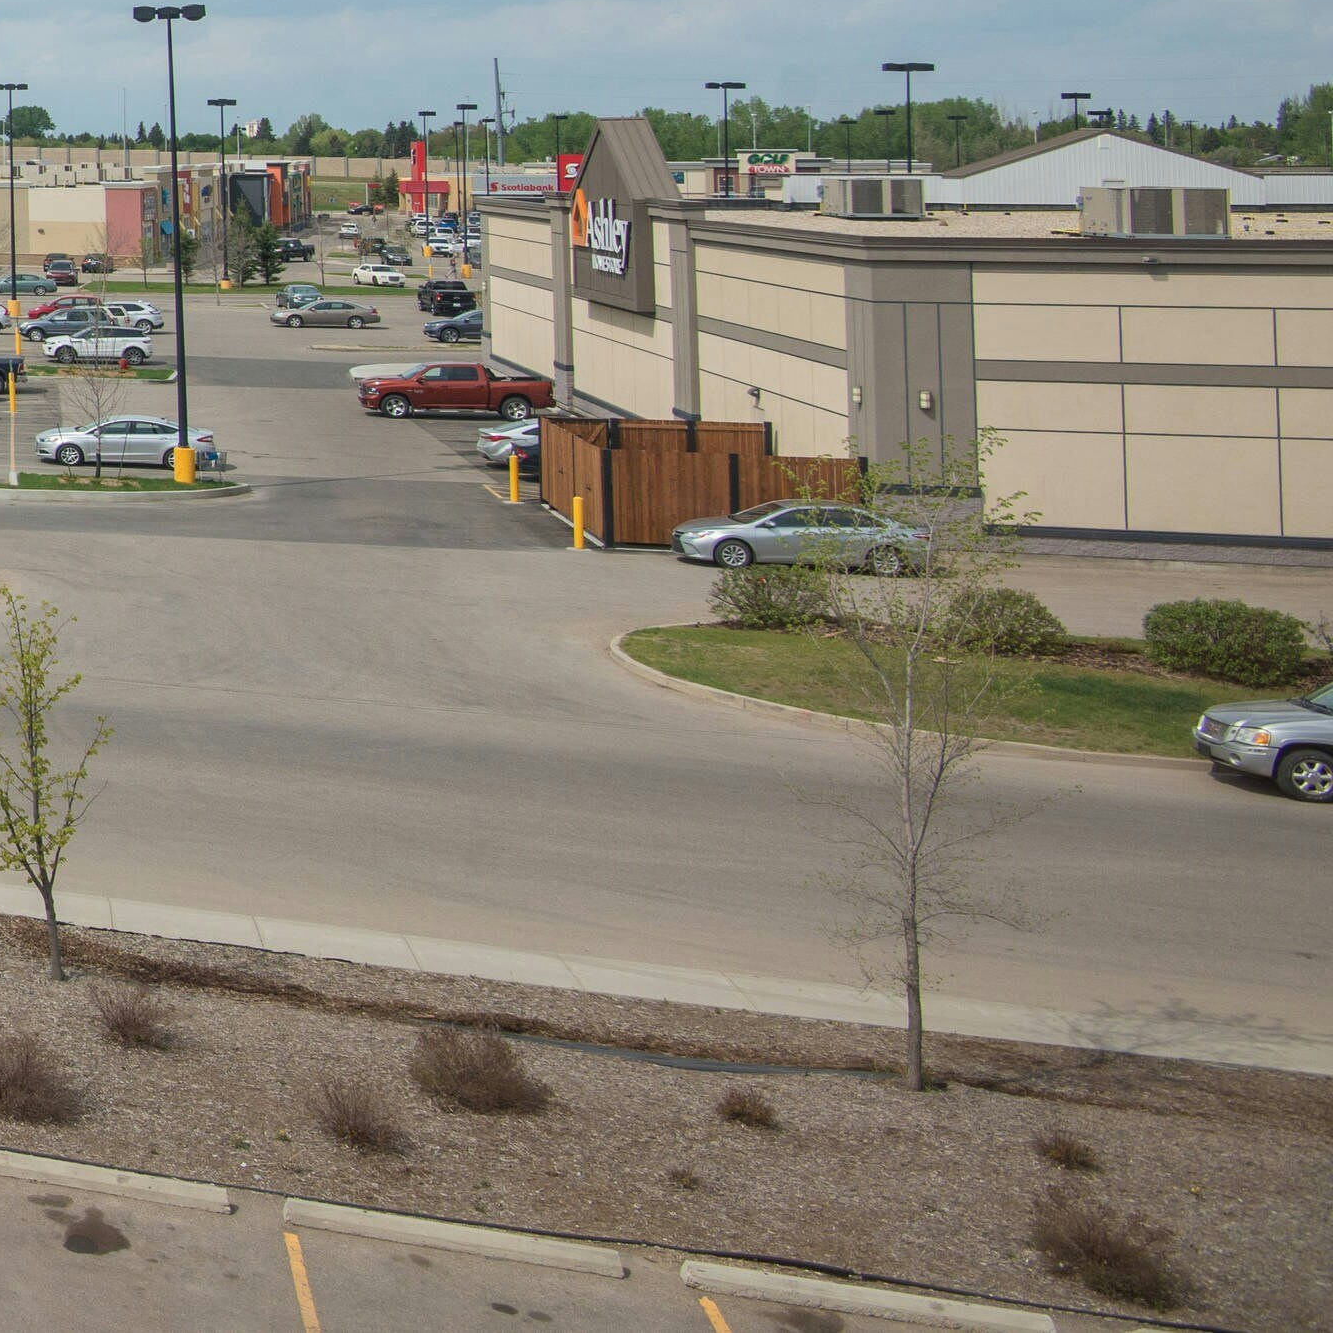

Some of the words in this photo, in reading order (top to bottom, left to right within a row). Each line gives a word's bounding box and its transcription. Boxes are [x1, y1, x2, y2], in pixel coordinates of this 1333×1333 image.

[748, 153, 790, 165] GOLF
[753, 165, 786, 173] TOWN
[501, 183, 554, 192] Scotiabank
[585, 197, 629, 269] Ashley
